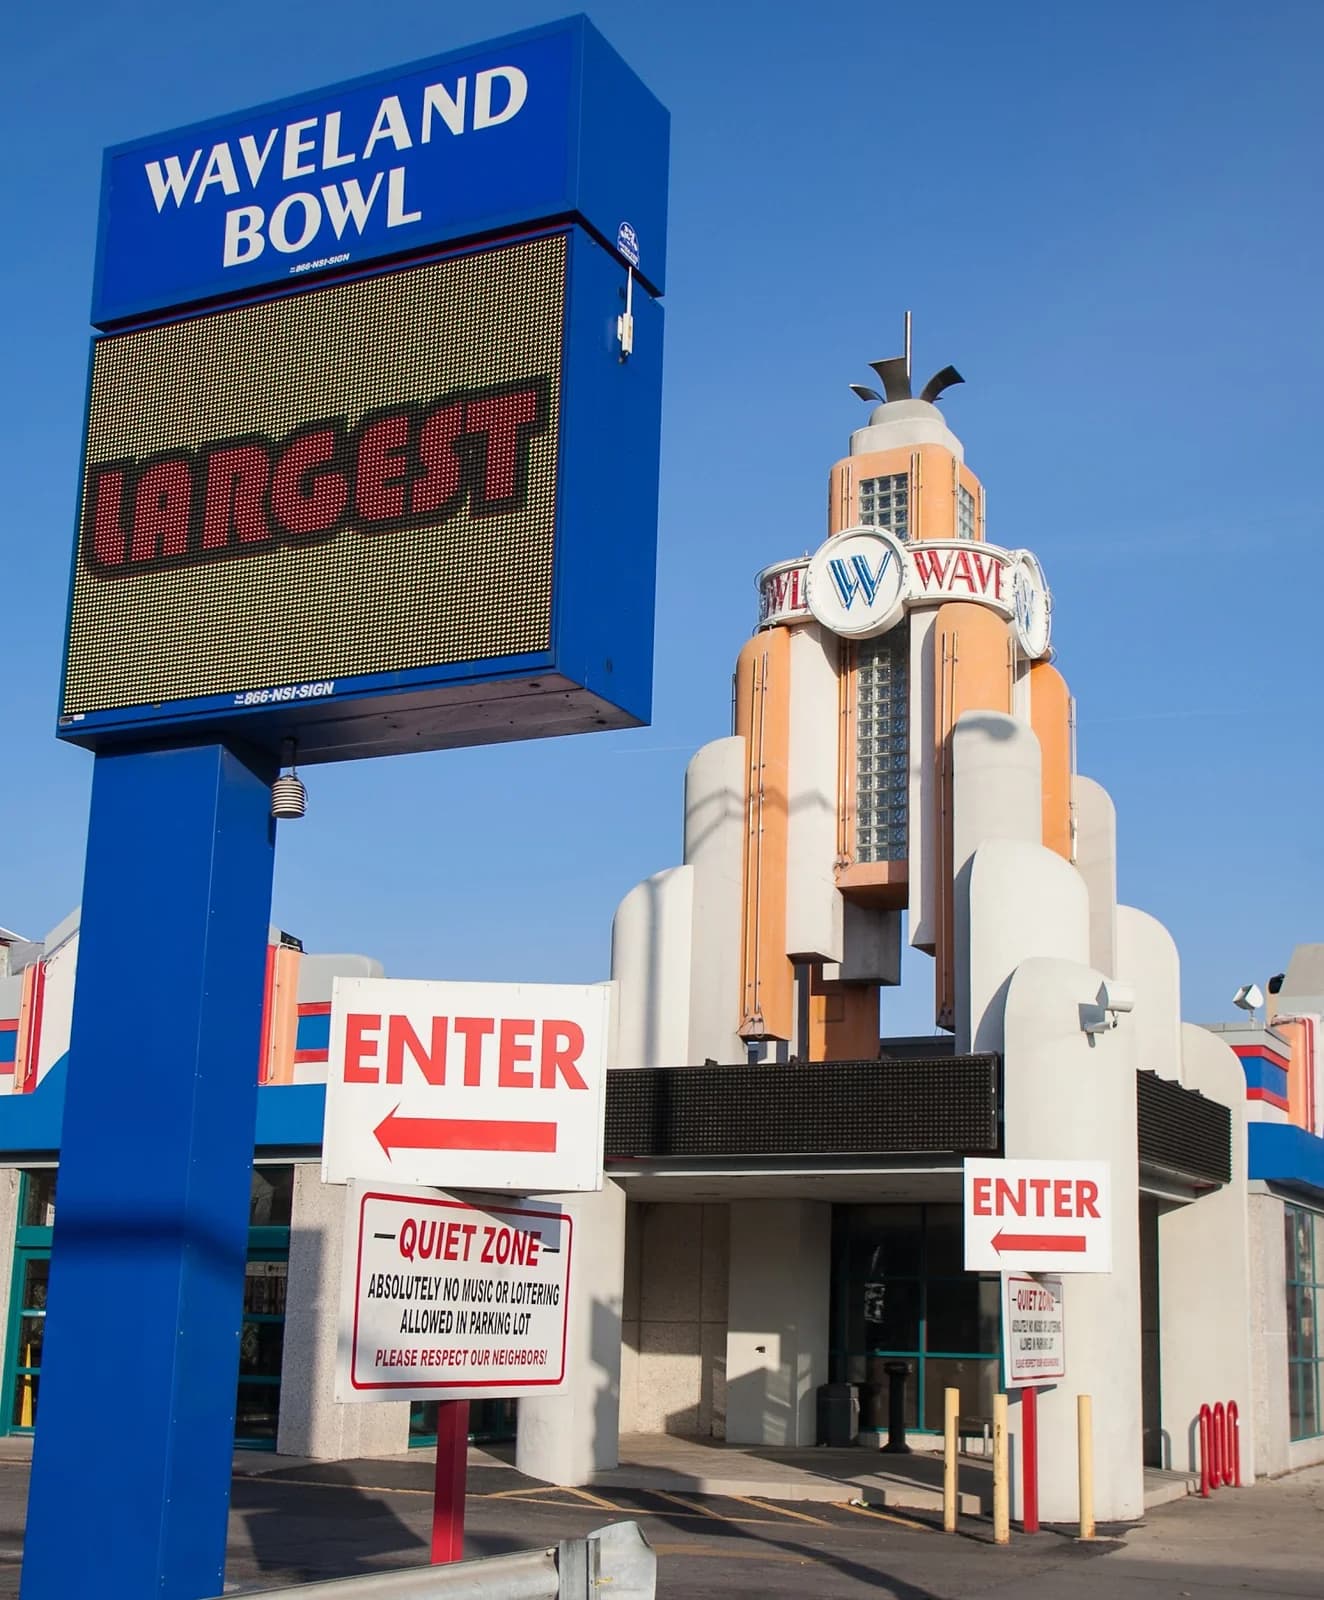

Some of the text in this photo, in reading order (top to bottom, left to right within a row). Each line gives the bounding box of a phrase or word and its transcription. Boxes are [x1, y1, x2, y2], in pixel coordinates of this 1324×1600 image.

[145, 65, 528, 213] WAVELAND
[223, 167, 421, 268] BOWL
[91, 390, 536, 567] LARGEST
[827, 550, 893, 611] W
[344, 1013, 589, 1090] ENTER
[973, 1178, 1101, 1218] ENTER
[399, 1218, 542, 1266] QUIET ZONE
[368, 1273, 560, 1305] ABSOLUTELY NO MUSIC OR LOITERING
[400, 1308, 531, 1335] ALLOWED IN PARKING LOT
[376, 1349, 548, 1366] PLEASE RESPECT OUR NEIGHBORS!
